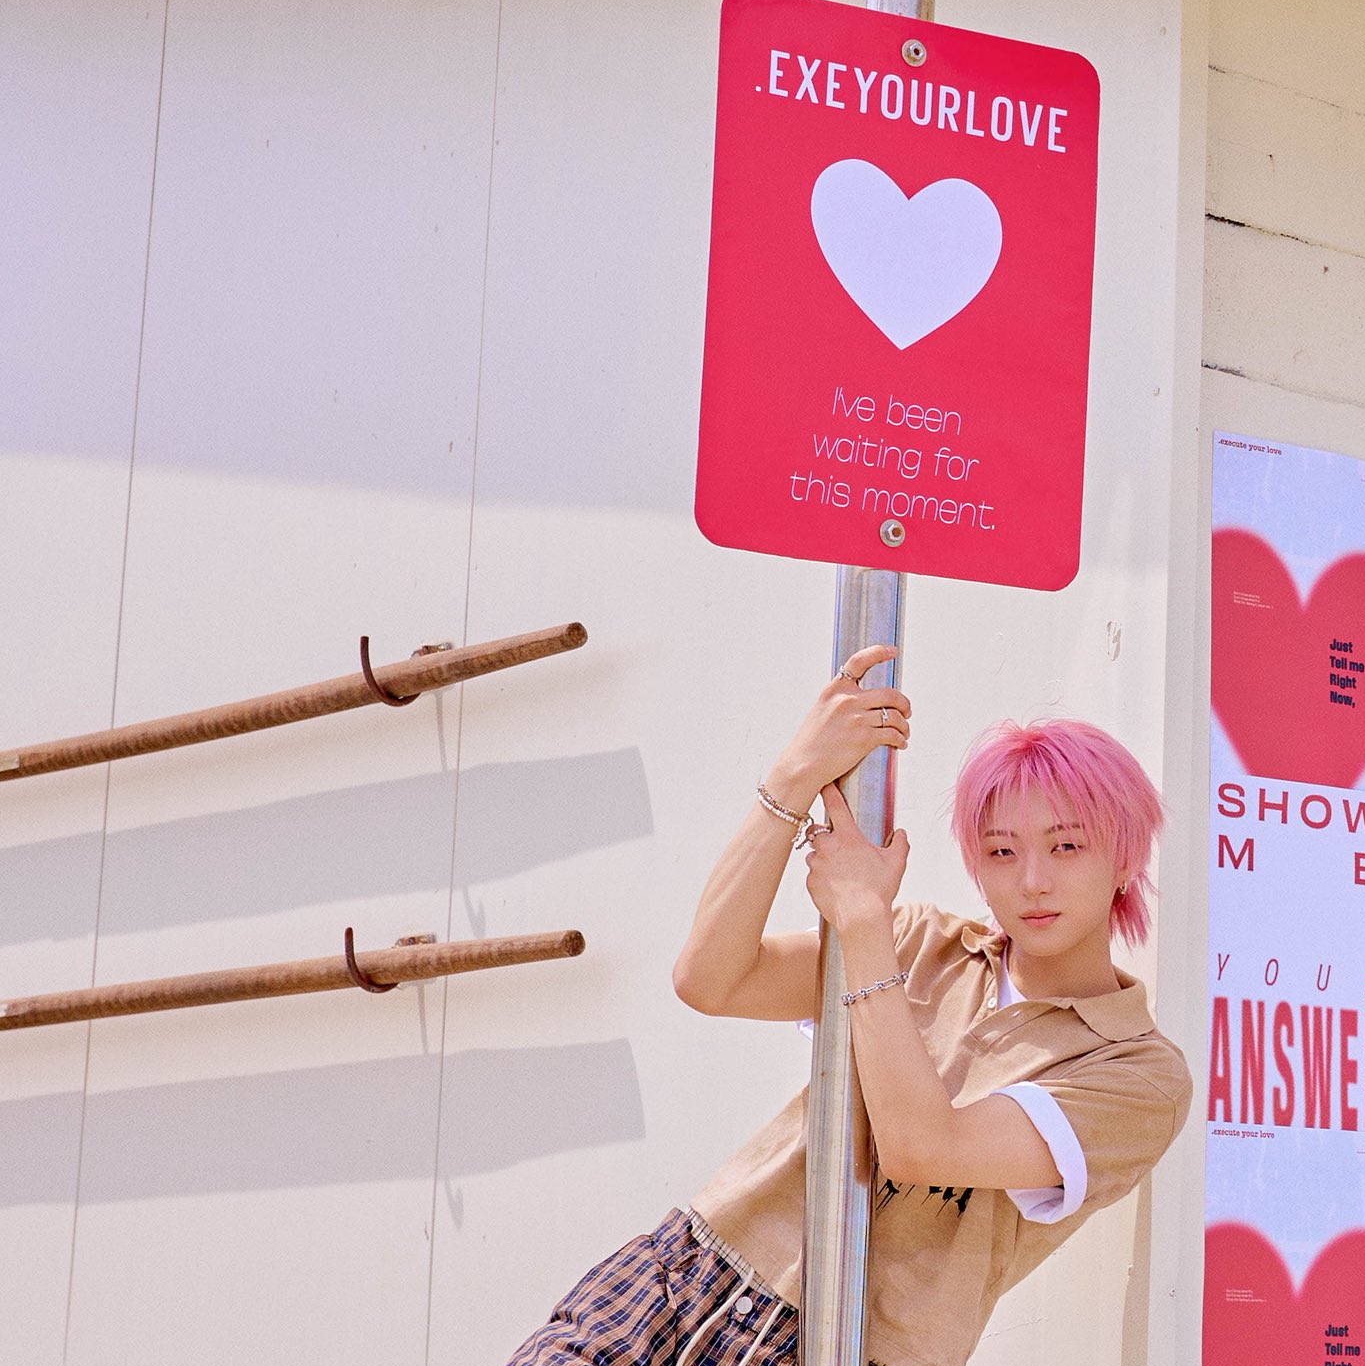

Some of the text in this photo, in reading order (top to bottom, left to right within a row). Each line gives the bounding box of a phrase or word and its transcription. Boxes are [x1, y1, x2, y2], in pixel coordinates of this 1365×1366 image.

[755, 49, 1068, 153] .EXEYOURLOVE
[833, 386, 962, 435] I've been
[1248, 442, 1265, 452] your
[1267, 445, 1282, 455] love
[814, 434, 979, 482] waiting for
[790, 472, 995, 530] this moment.
[1330, 639, 1353, 653] Just
[1330, 656, 1364, 672] Tell me
[1330, 674, 1356, 689] Right
[1241, 1130, 1258, 1139] your
[1259, 1129, 1275, 1138] love
[1325, 1325, 1348, 1337] Just
[1325, 1343, 1360, 1356] Tell me
